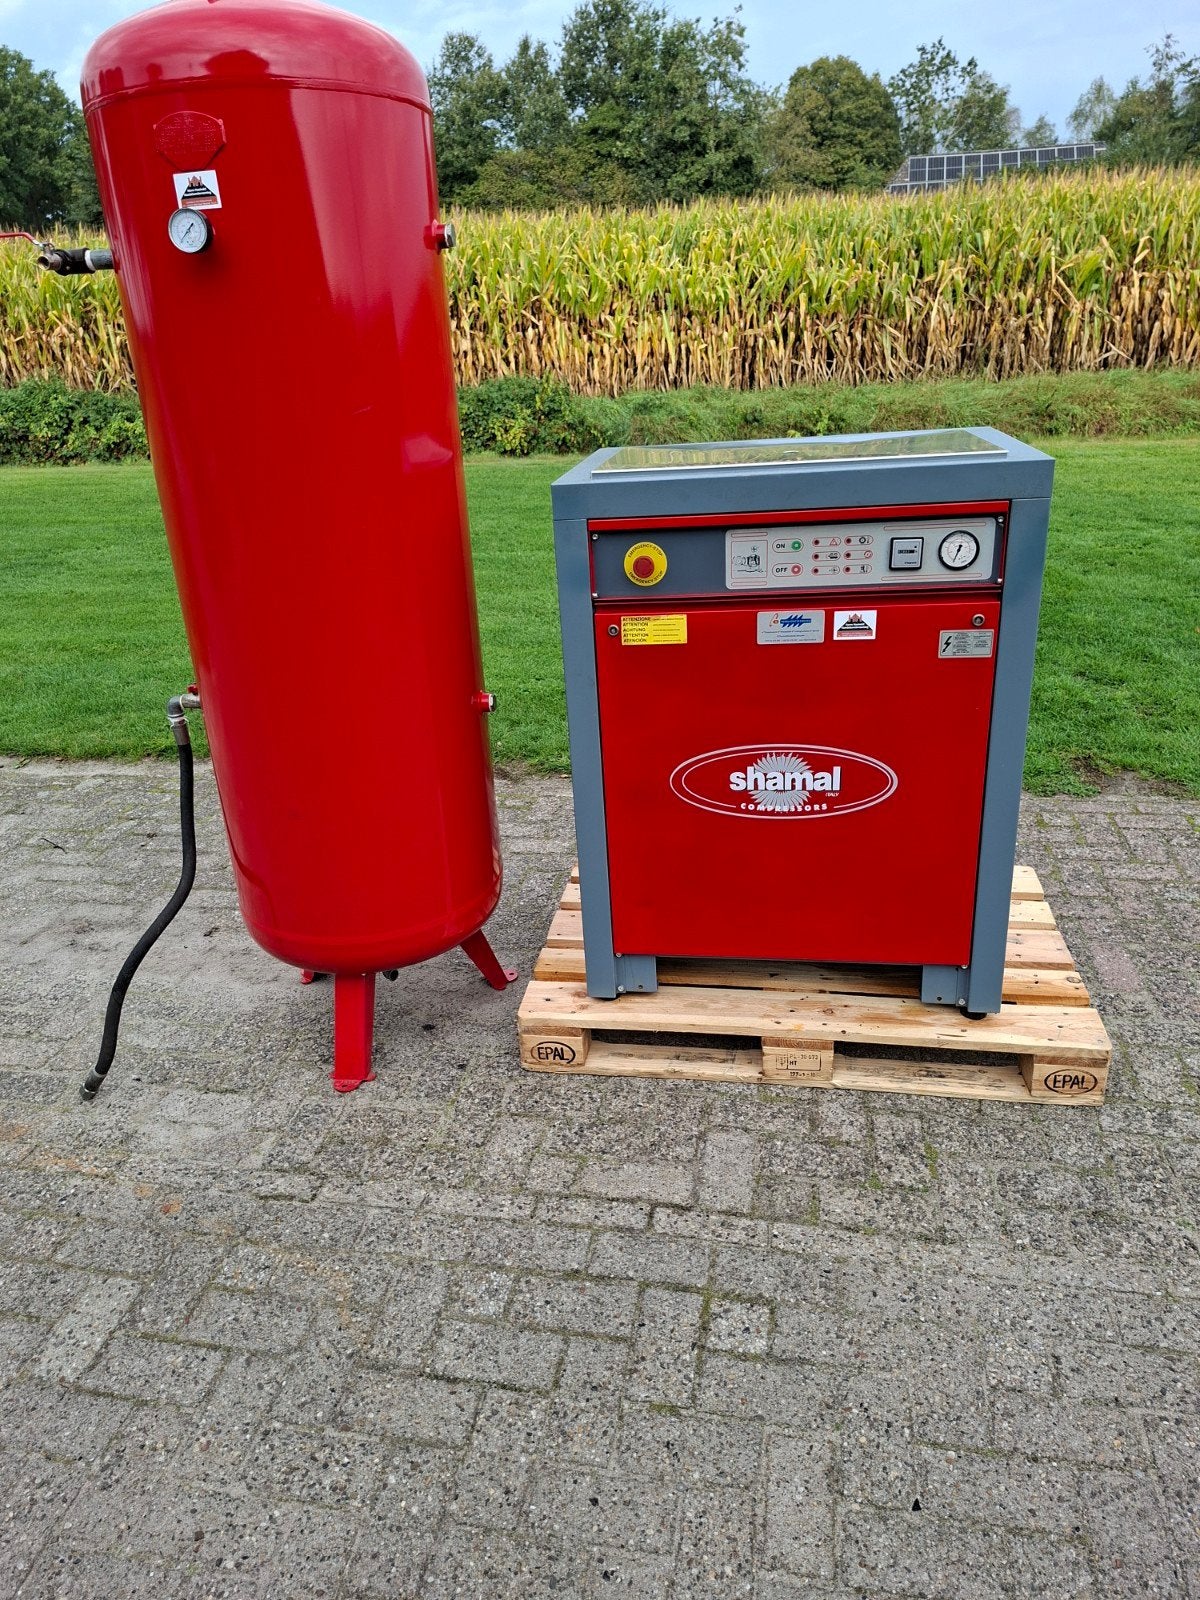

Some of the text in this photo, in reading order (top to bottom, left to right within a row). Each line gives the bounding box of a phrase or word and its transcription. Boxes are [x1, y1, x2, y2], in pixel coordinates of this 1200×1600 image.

[729, 766, 841, 791] shamal
[740, 803, 828, 812] COMPRESSORS
[537, 1046, 570, 1061] EPAL
[1052, 1074, 1089, 1090] EPAL
